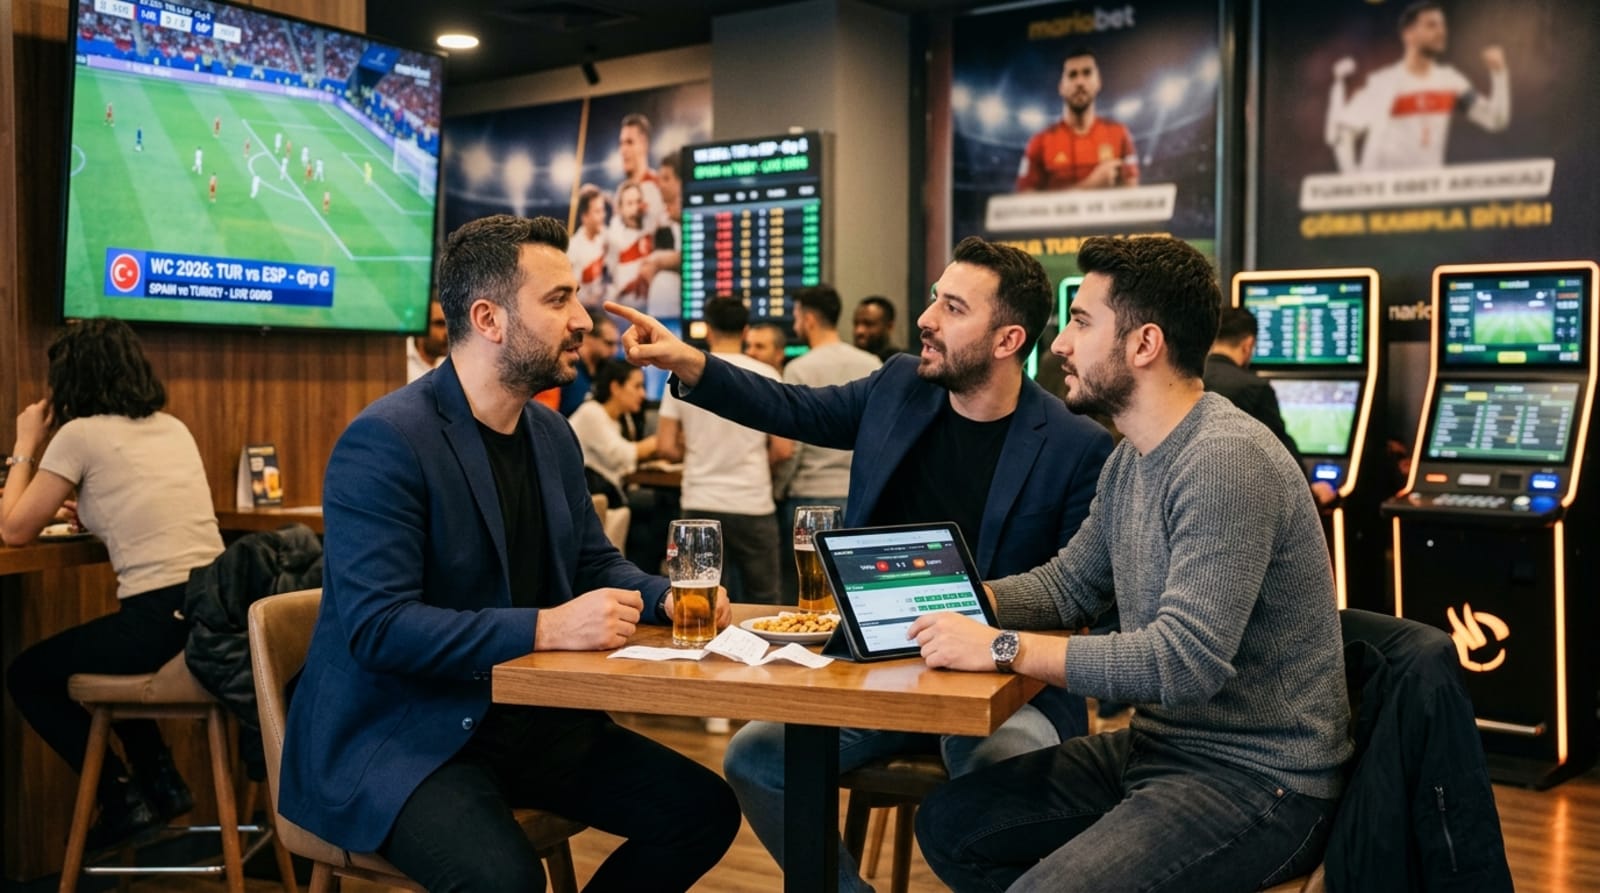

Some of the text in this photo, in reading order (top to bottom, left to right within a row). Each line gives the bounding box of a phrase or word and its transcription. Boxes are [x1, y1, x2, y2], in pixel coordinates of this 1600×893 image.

[1028, 4, 1136, 40] mariobet
[150, 257, 174, 275] WC
[176, 260, 214, 280] 2026:
[216, 263, 243, 281] TUR
[262, 265, 287, 284] ESP
[296, 269, 317, 289] Grp
